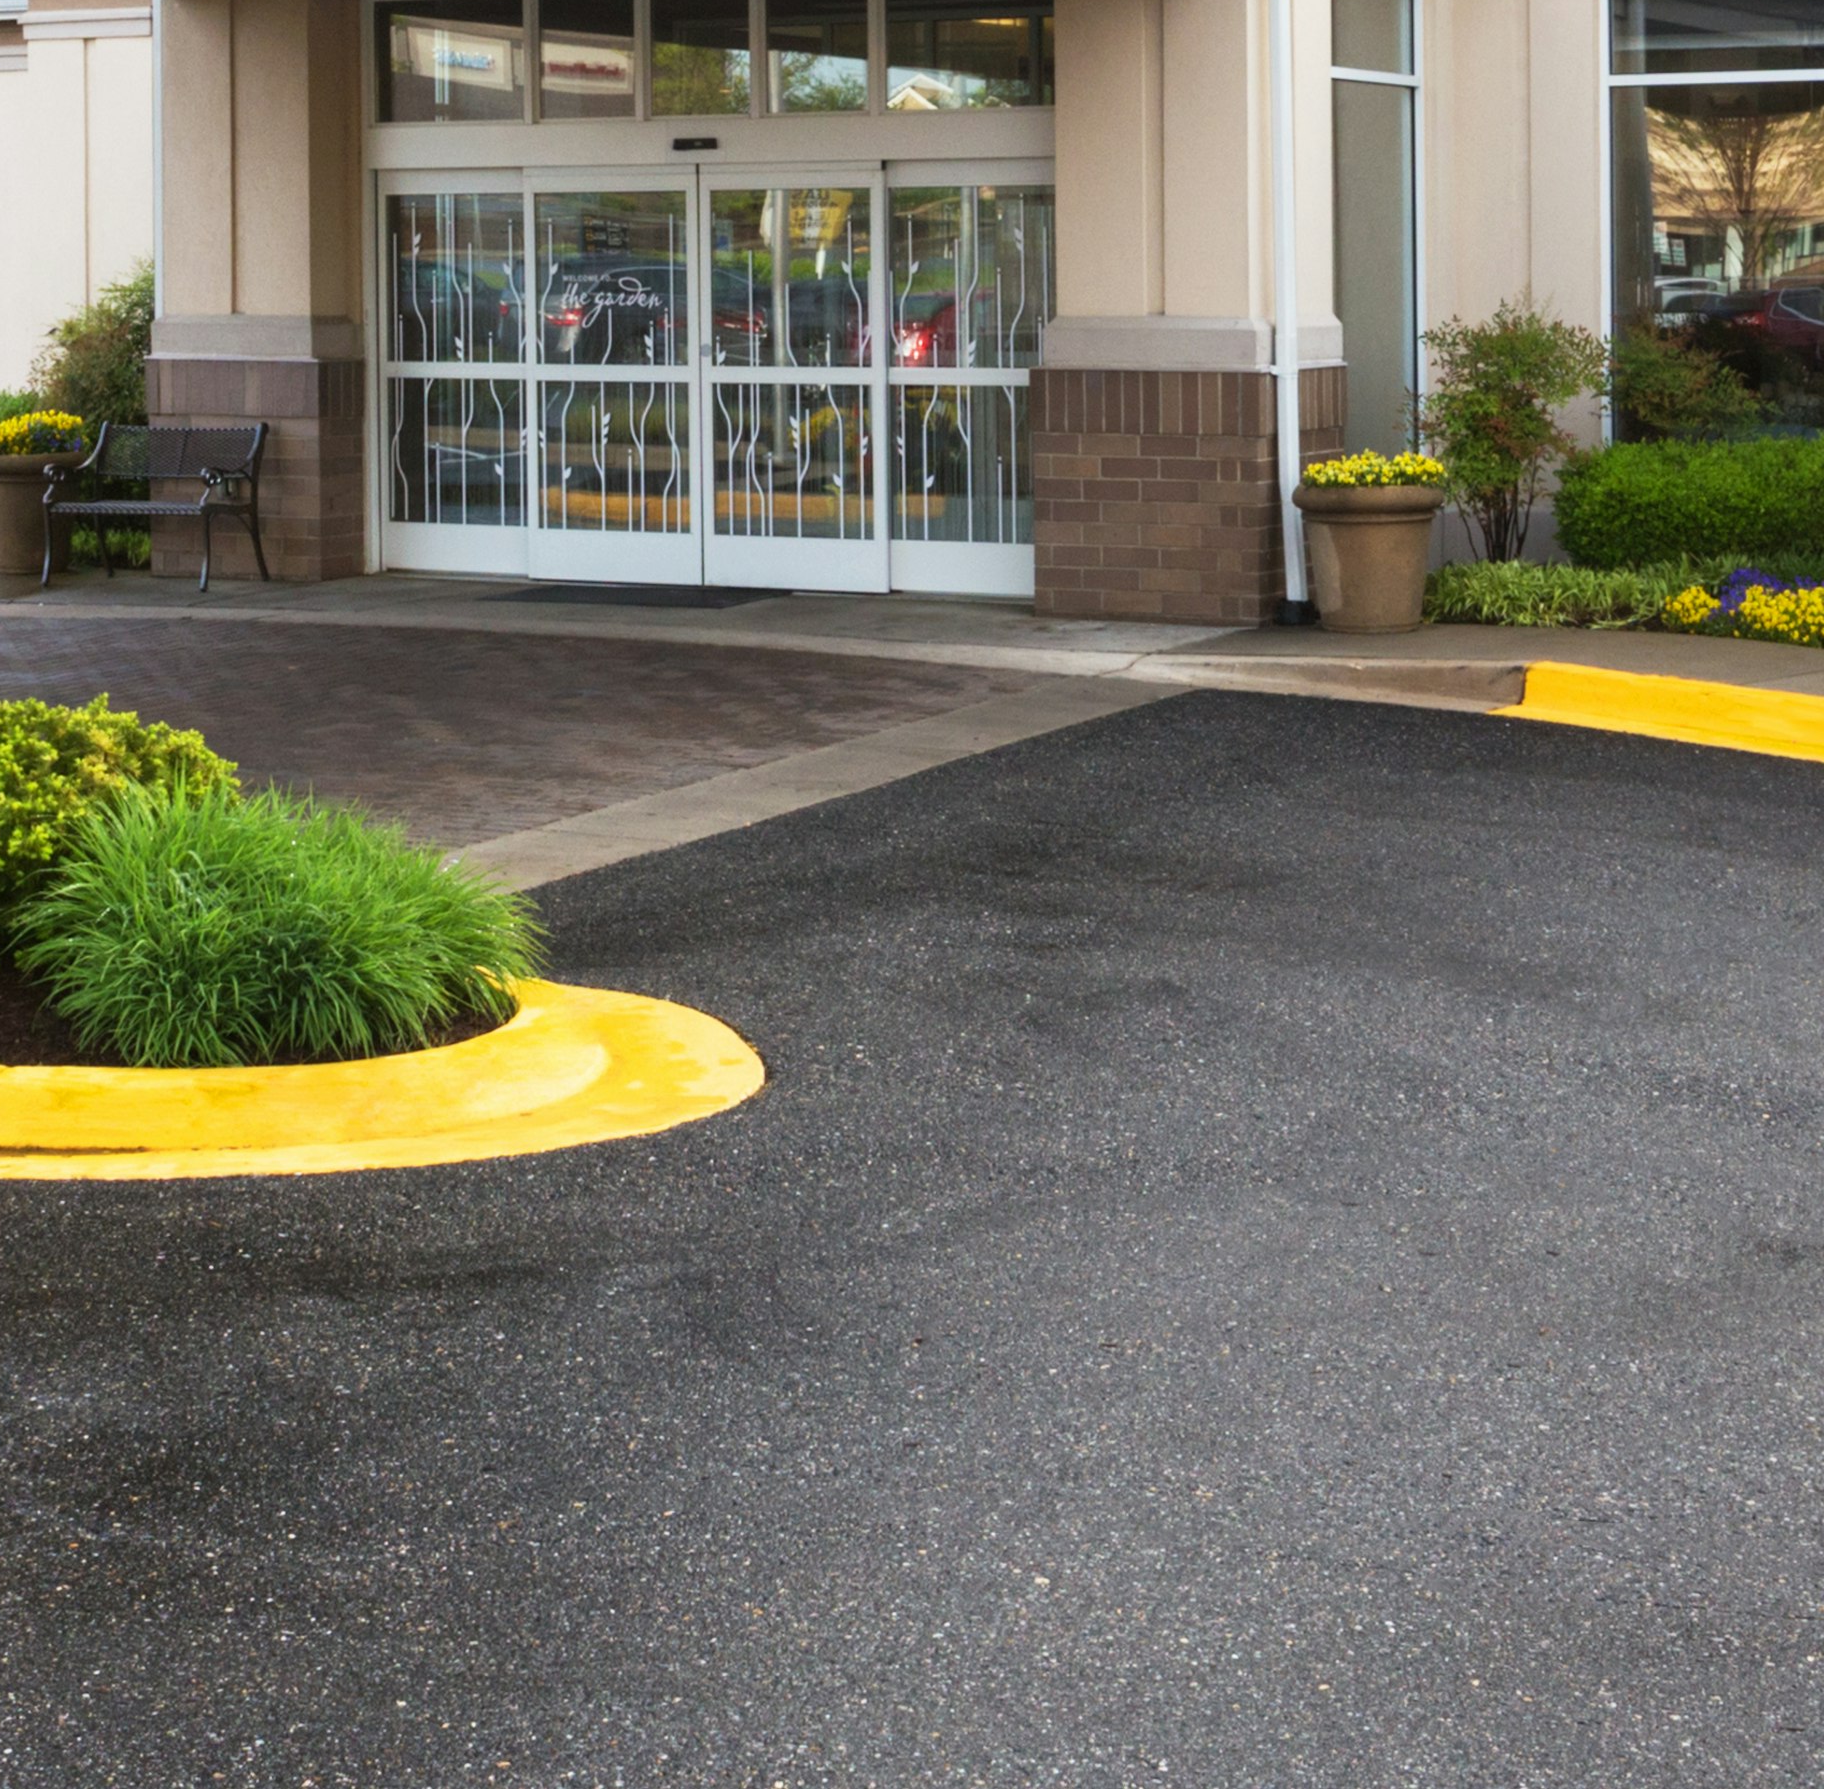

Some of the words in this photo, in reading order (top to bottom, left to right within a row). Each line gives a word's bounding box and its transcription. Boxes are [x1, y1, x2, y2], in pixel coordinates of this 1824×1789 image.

[562, 274, 598, 283] WELCOME
[561, 282, 591, 306] the
[582, 276, 663, 328] garden
